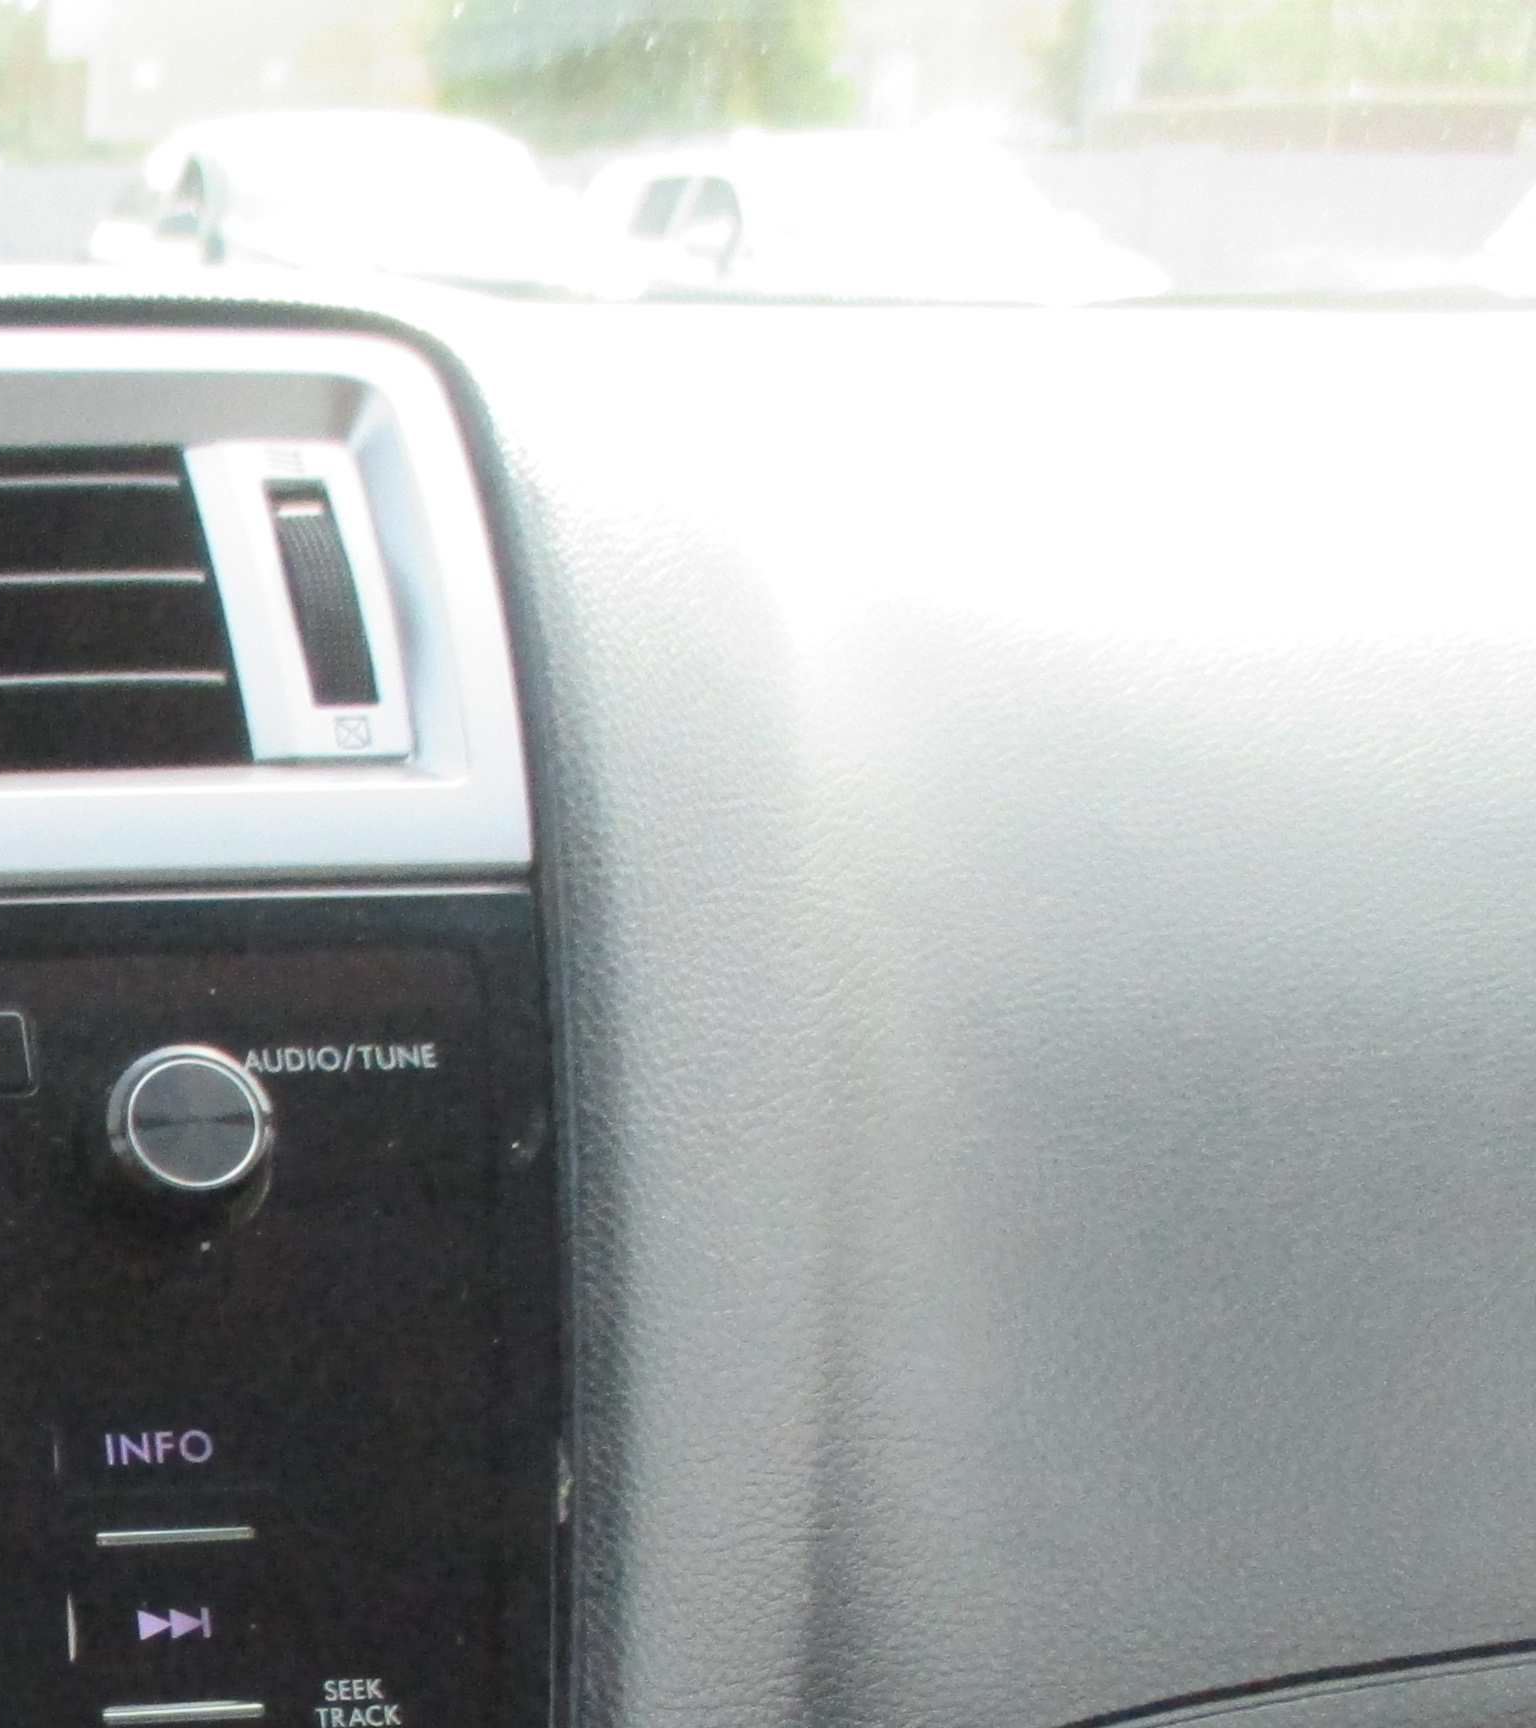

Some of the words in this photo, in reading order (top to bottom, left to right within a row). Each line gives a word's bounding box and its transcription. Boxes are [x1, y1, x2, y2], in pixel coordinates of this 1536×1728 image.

[244, 1042, 437, 1076] AUDIO/TUNE
[105, 1429, 214, 1466] INFO
[324, 1678, 385, 1702] SEEK
[316, 1704, 402, 1728] TRACK
